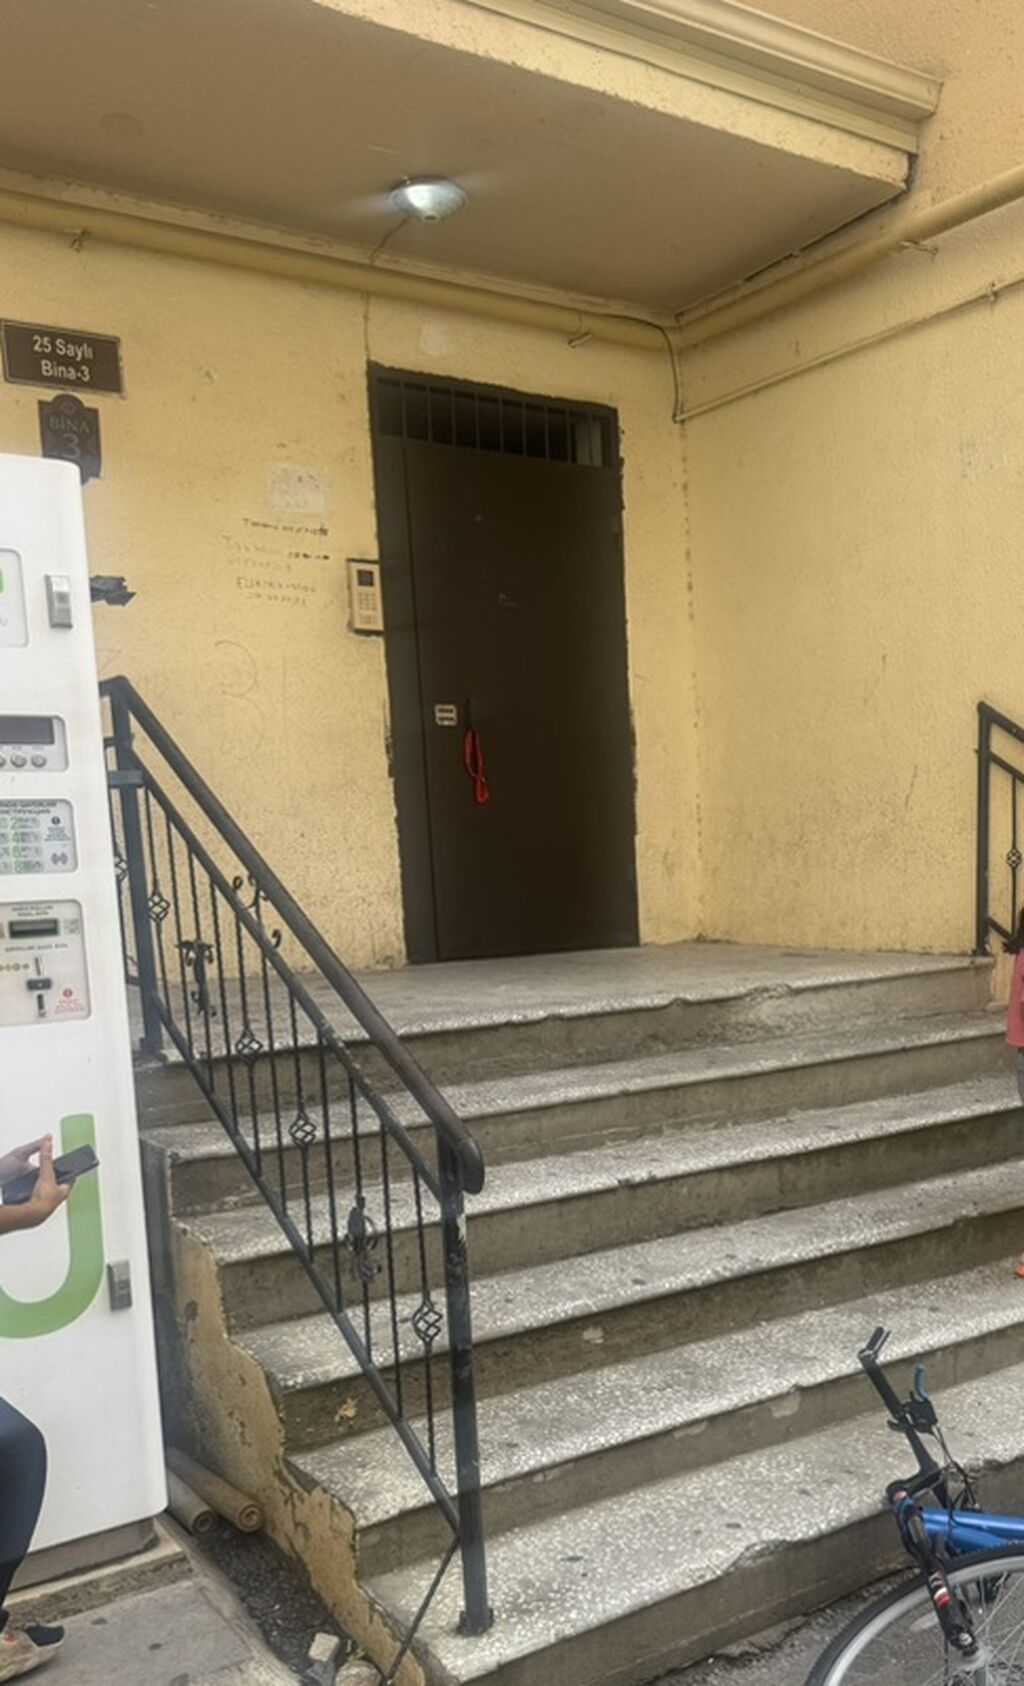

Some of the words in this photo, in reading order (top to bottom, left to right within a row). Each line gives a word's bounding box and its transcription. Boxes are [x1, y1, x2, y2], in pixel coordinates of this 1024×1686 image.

[32, 335, 51, 353] 25
[41, 360, 90, 382] Bina-3
[62, 433, 80, 459] 3
